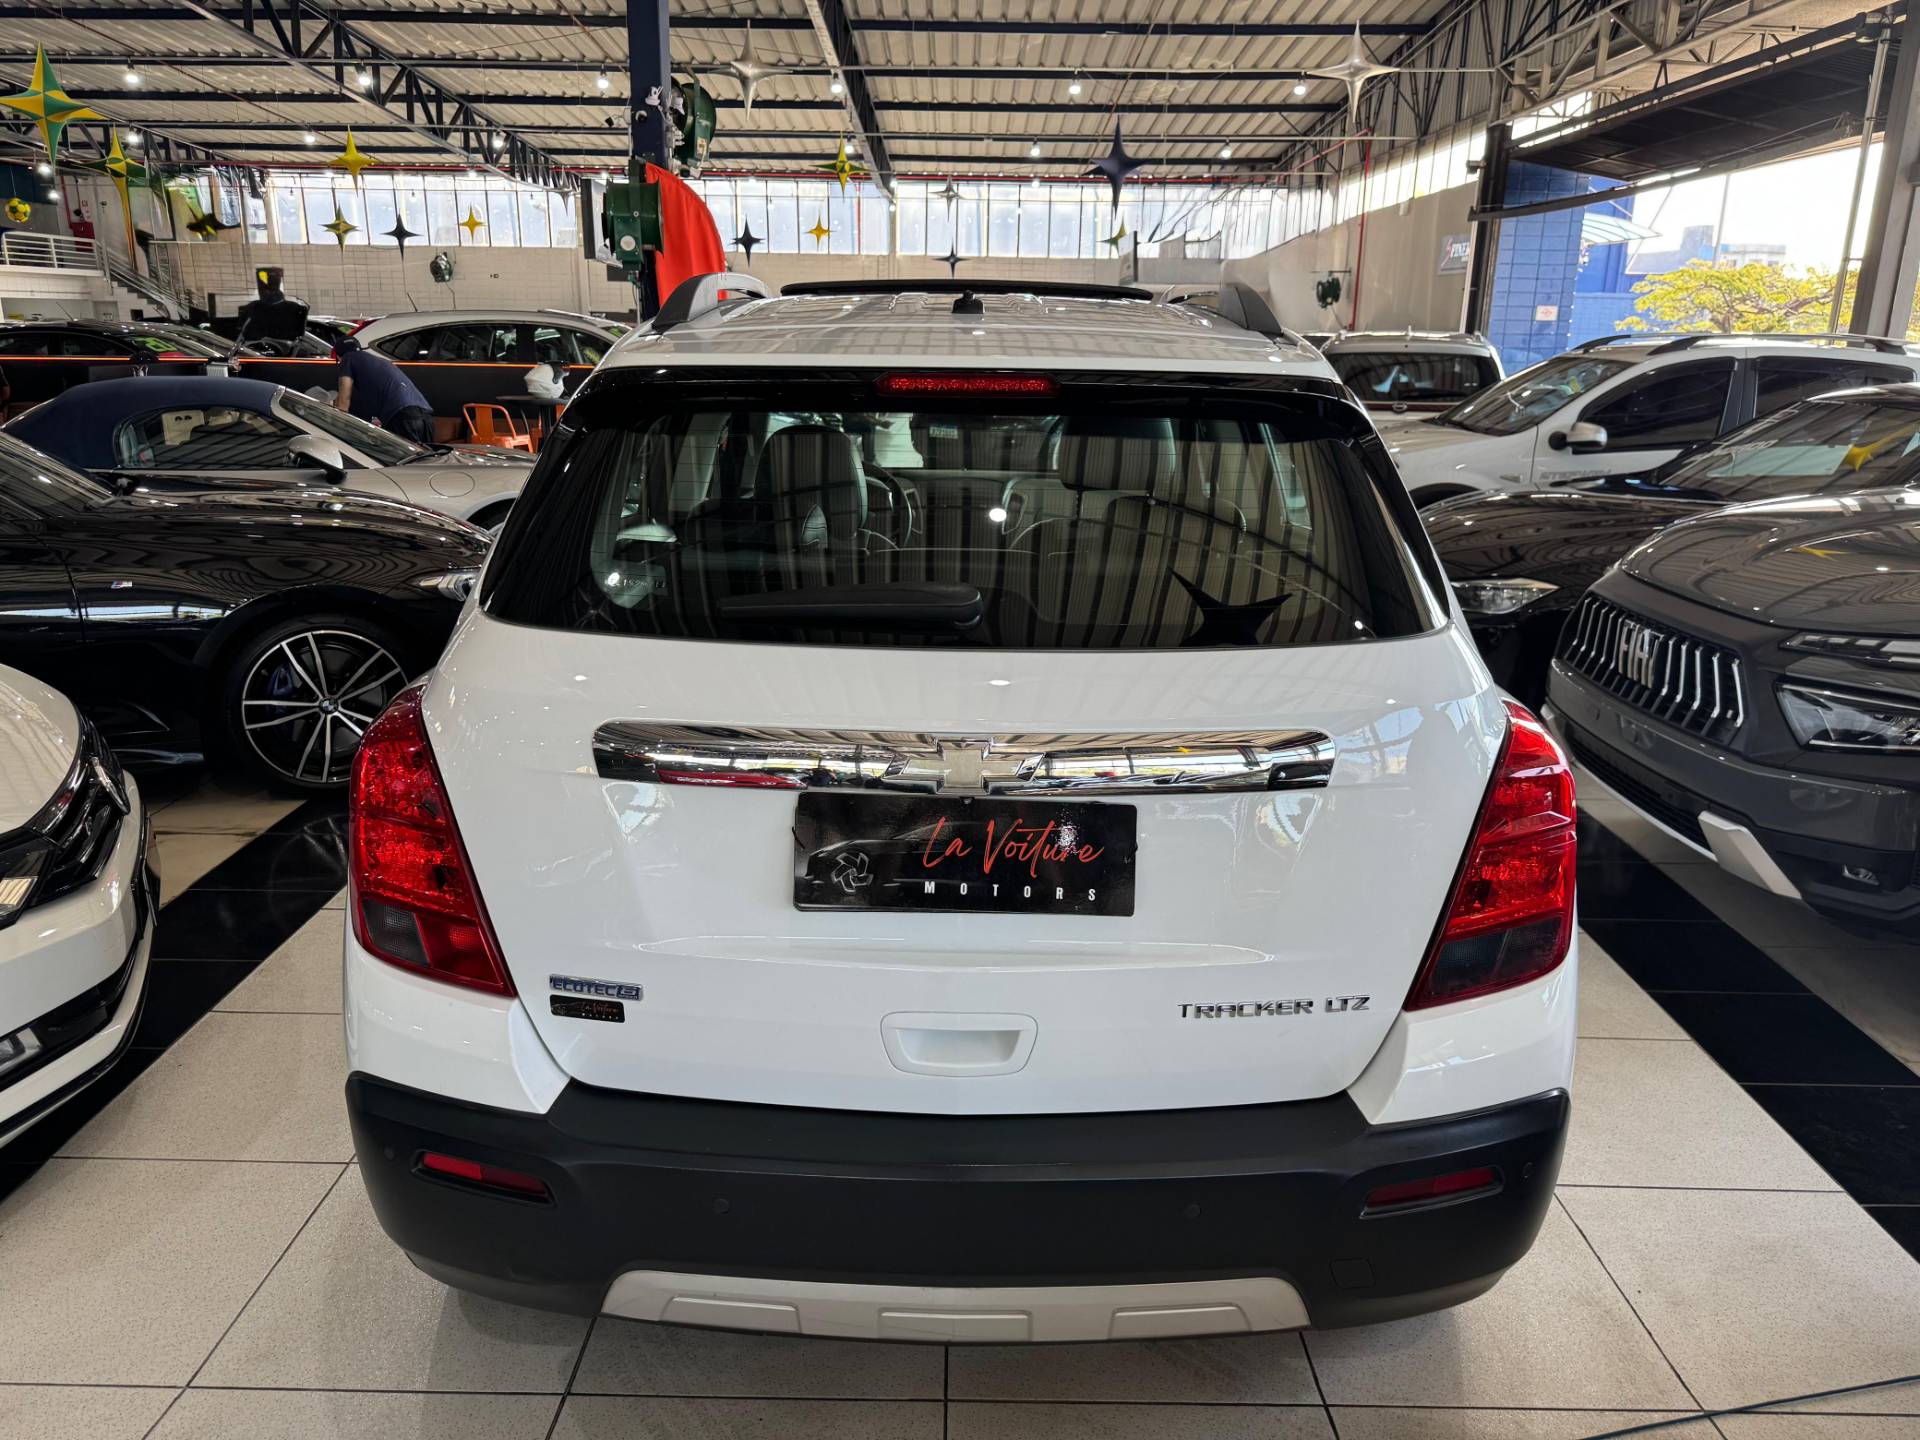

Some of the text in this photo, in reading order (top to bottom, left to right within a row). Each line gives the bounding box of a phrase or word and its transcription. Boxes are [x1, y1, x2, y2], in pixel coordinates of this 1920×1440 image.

[1618, 619, 1665, 689] FIAT
[922, 816, 1105, 878] La Voiture
[924, 881, 1096, 901] MOTORS
[551, 977, 616, 997] ECOTEC
[1177, 994, 1371, 1019] TRACKER LTZ
